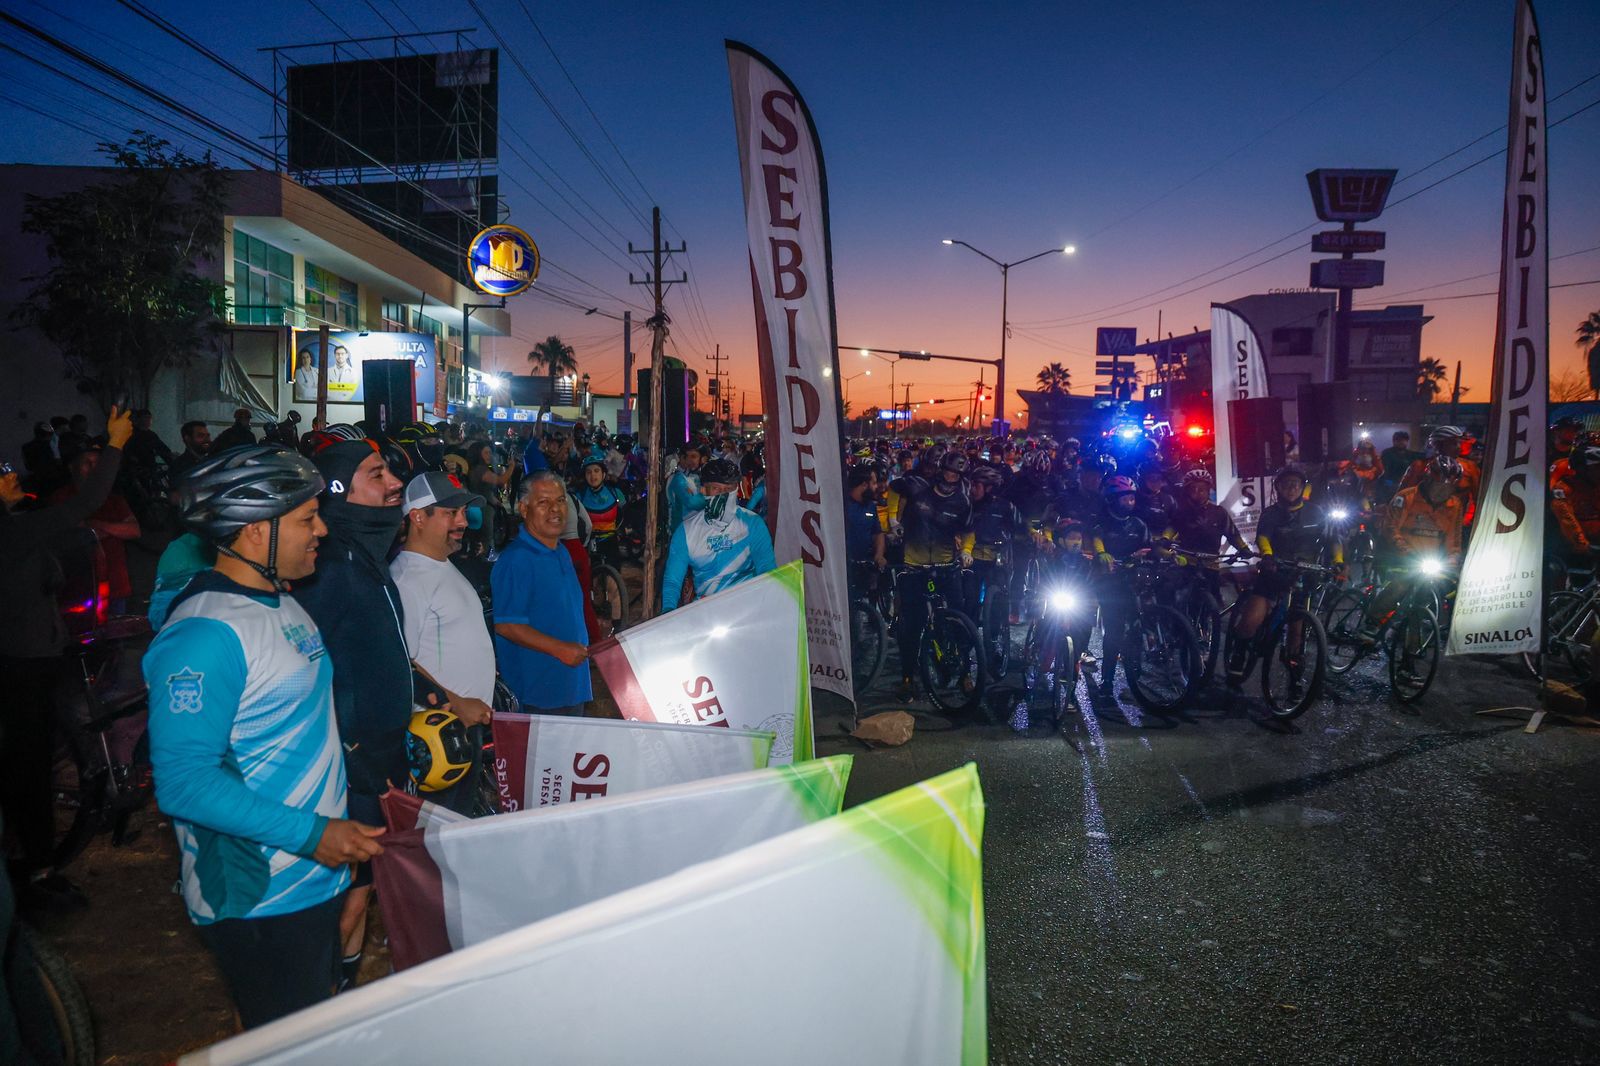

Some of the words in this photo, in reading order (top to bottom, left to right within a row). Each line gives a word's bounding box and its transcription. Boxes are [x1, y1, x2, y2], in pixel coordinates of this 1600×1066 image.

[1495, 36, 1539, 533] SEBIDES
[761, 90, 828, 567] SEBIDES
[1521, 570, 1536, 579] DE
[1469, 590, 1533, 605] DESARROLLO
[1455, 601, 1529, 616] SUSTENTABLE
[1464, 626, 1534, 645] SINALOA
[543, 767, 551, 776] Y
[495, 758, 513, 812] SENT
